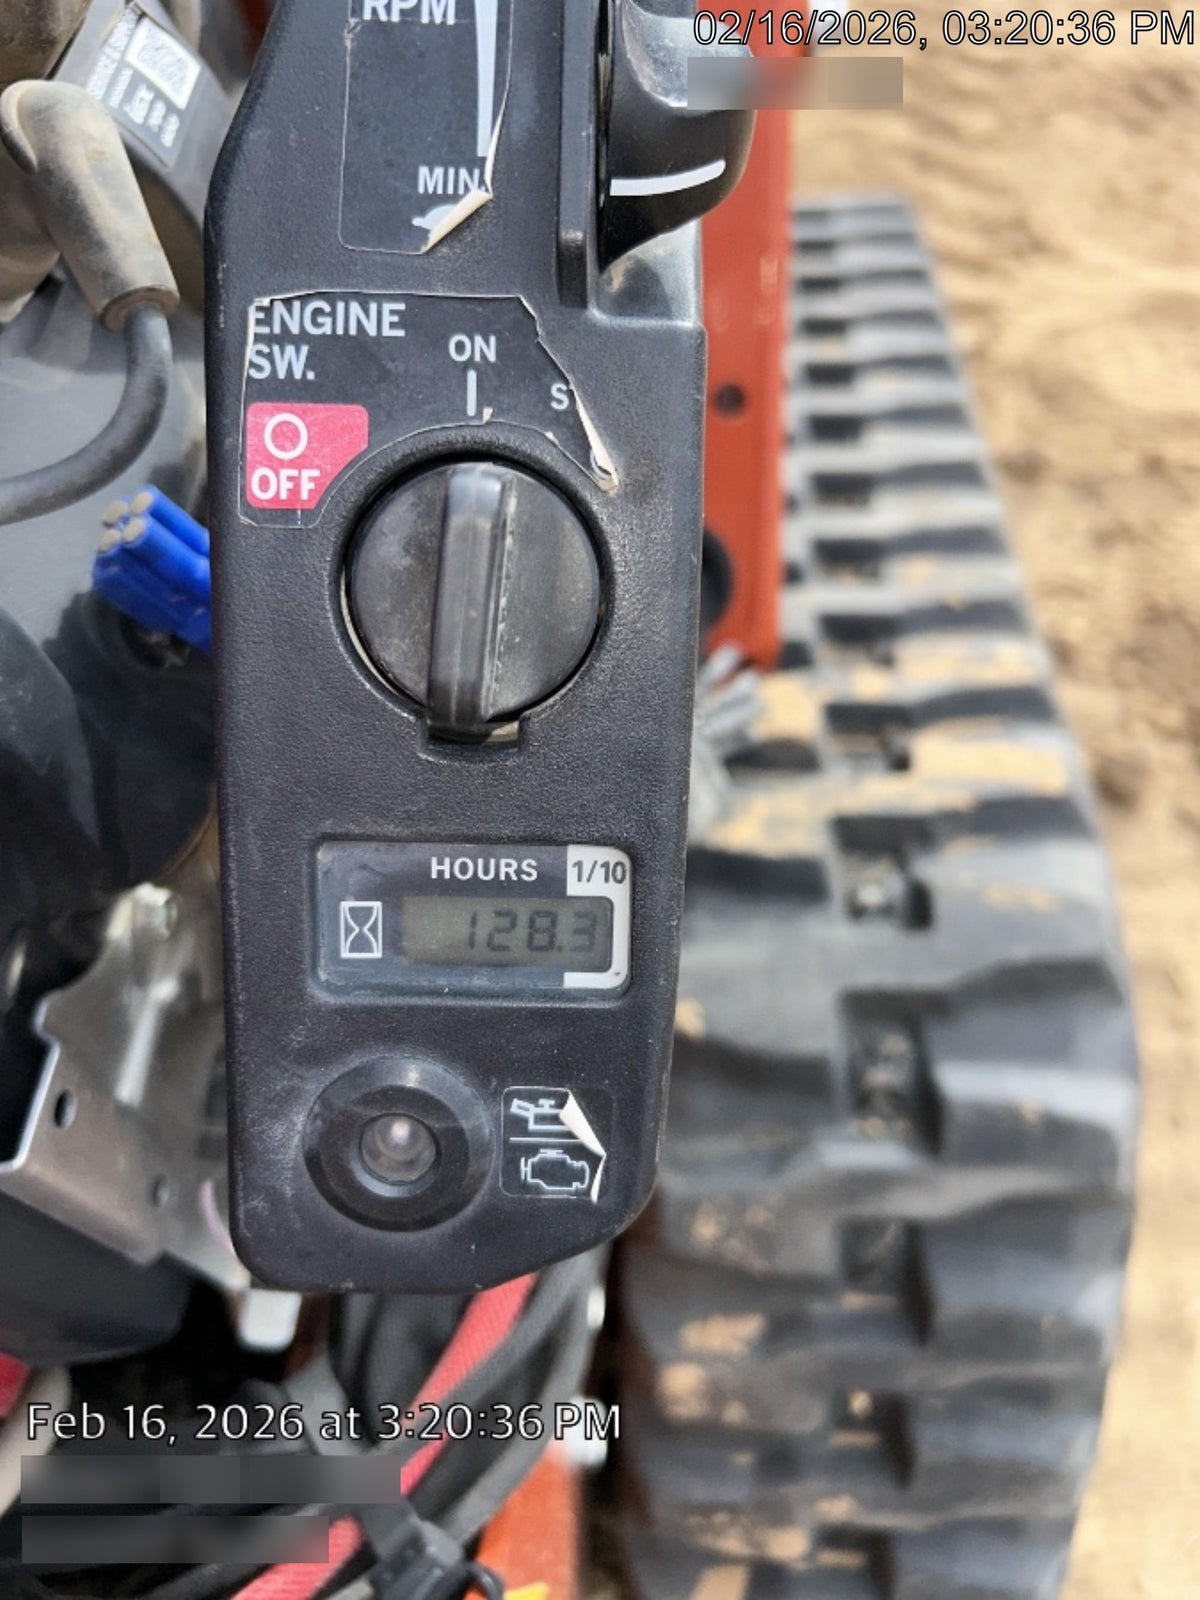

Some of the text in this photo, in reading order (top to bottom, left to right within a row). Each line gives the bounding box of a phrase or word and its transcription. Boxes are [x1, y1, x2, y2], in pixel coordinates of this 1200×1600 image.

[363, 0, 456, 25] RPM
[252, 301, 406, 337] ENGINE
[249, 343, 316, 381] SW.
[449, 334, 497, 363] ON
[251, 468, 320, 500] OFF
[430, 856, 538, 881] HOURS
[572, 860, 627, 884] 1/10
[466, 910, 598, 951] 128.3
